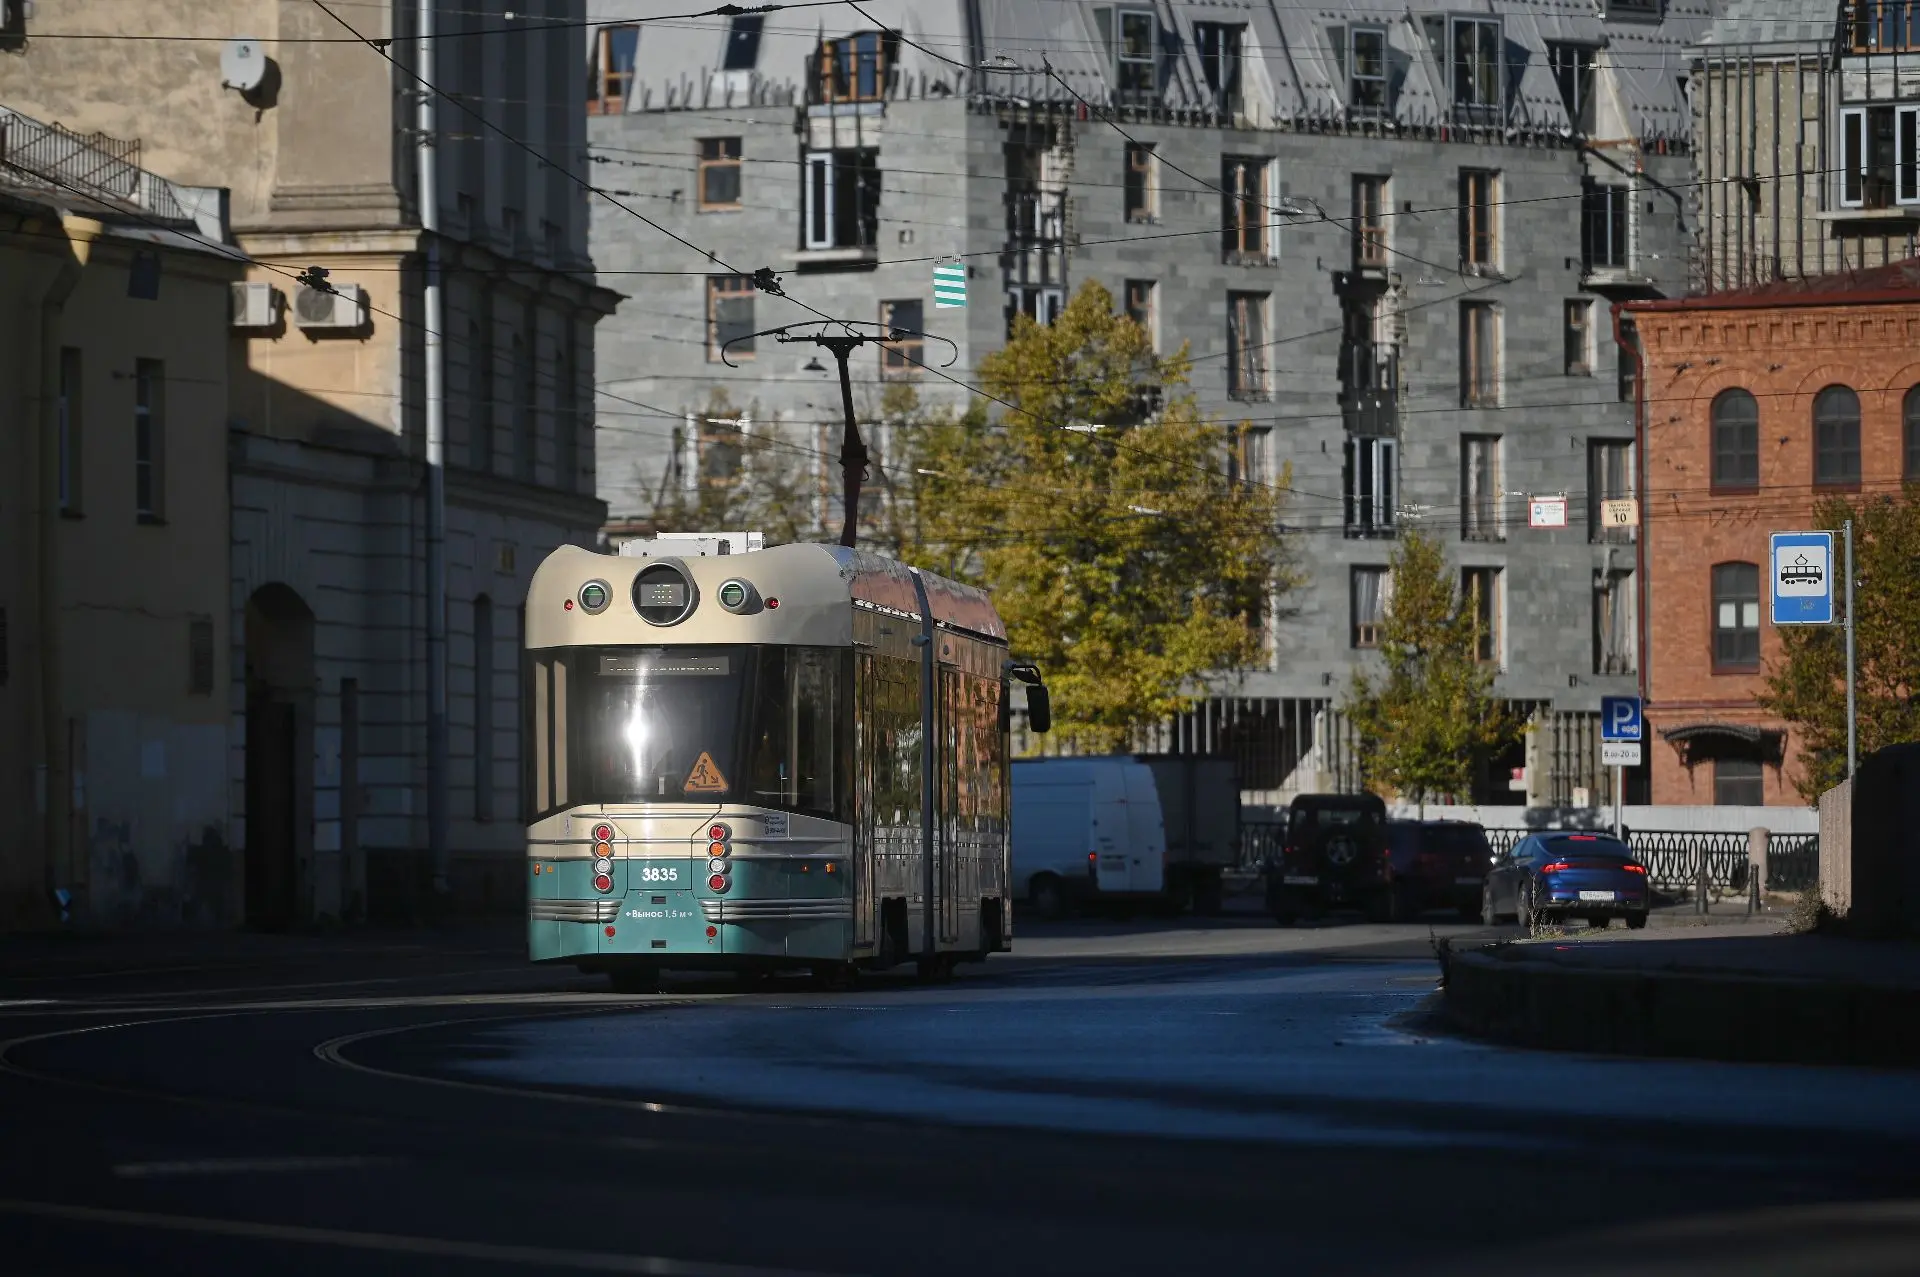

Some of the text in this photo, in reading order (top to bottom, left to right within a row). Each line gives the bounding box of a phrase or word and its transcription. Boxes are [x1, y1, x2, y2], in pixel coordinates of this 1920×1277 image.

[1614, 513, 1627, 523] 10
[1612, 701, 1634, 734] P
[642, 867, 678, 881] 3835
[632, 910, 663, 918] Вынос
[664, 910, 677, 919] 1,5
